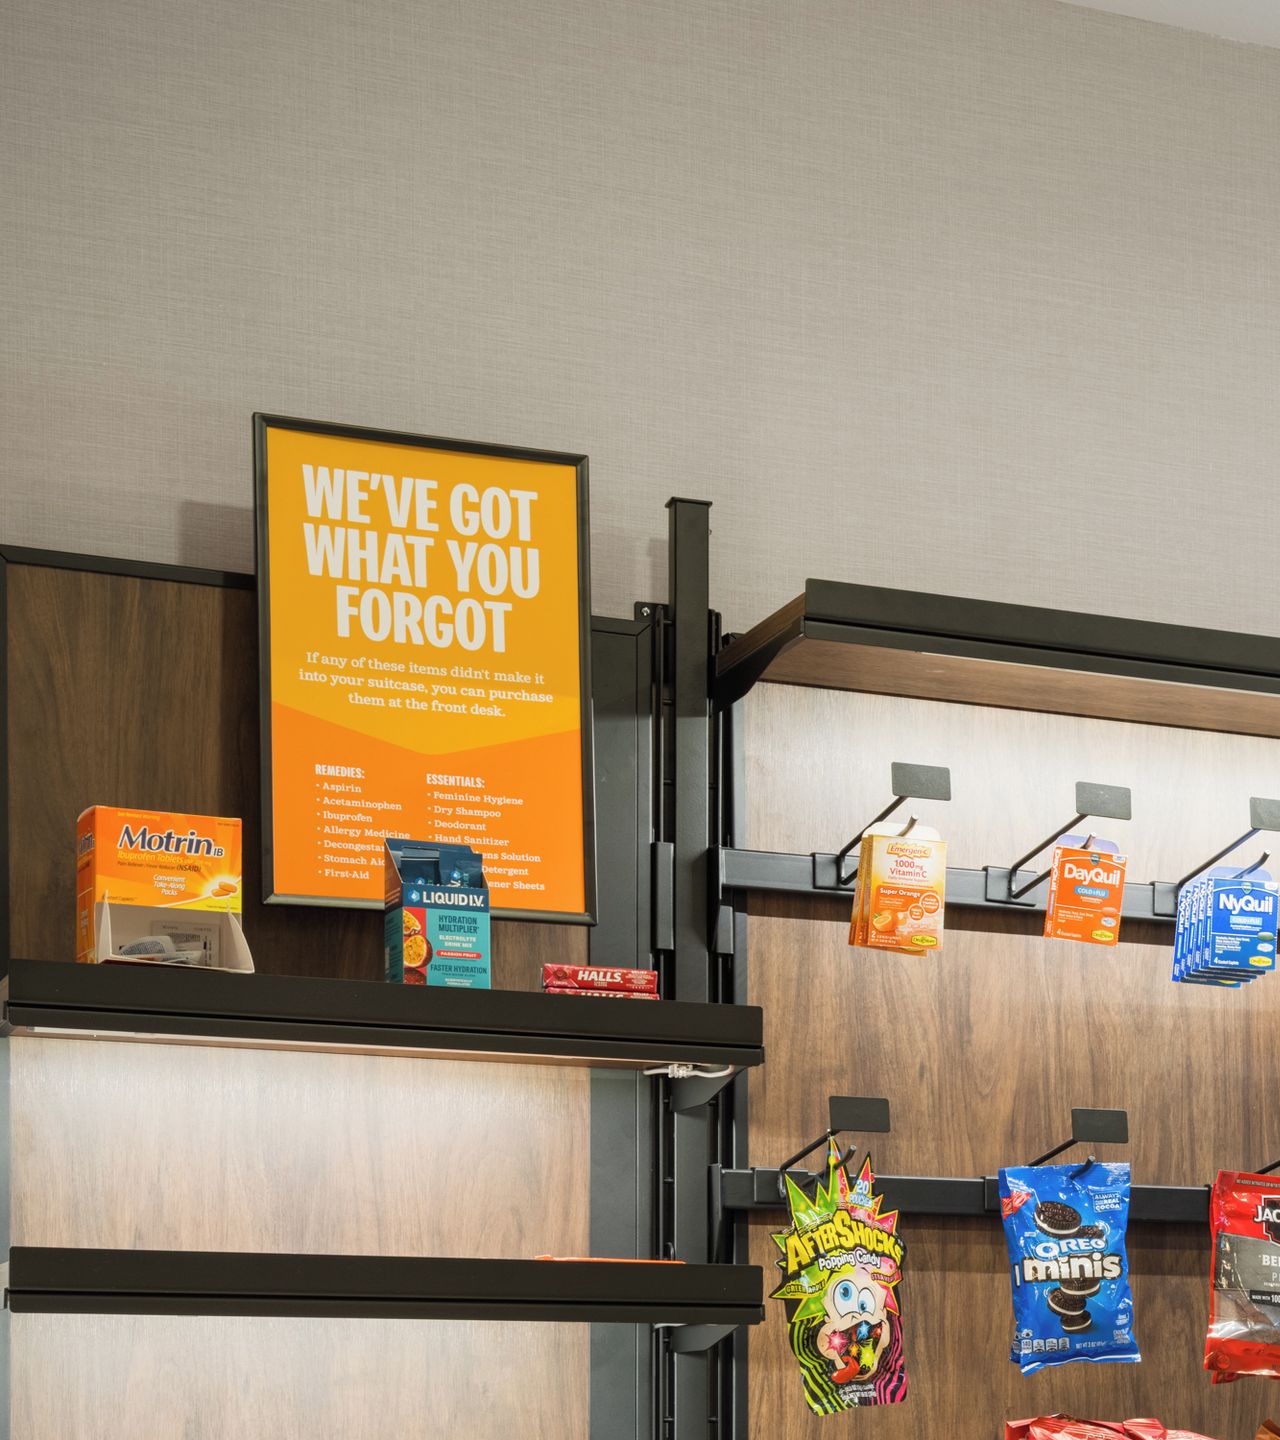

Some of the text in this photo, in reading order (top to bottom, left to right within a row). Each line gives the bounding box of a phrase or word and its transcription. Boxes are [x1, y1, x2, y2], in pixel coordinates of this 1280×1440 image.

[302, 464, 538, 542] WE'VE GOT
[303, 523, 540, 598] WHAT YOU
[336, 586, 512, 653] FORGOT
[306, 652, 544, 684] If any of these items didn't make it
[299, 669, 553, 703] into your suitcase, you can purchase
[348, 693, 506, 717] them at the front desk.
[315, 764, 365, 779] REMEDIES:
[322, 782, 362, 793] Aspirin
[426, 773, 485, 789] ESSENTIALS:
[323, 796, 402, 811] Acetaminophen
[433, 791, 523, 806] Feminine Hygiene
[323, 811, 373, 823] Ibuprofen
[434, 806, 501, 819] Dry Shampoo
[323, 825, 411, 839] Allergy Medicine
[434, 819, 487, 830] Deodorant
[118, 824, 213, 857] Motrin
[435, 833, 510, 847] Hand Sanitizer
[324, 854, 367, 866] Stomach
[500, 851, 541, 863] Solution
[324, 868, 370, 880] First-Aid
[1064, 863, 1121, 886] DayQuil
[513, 880, 545, 891] Sheets
[422, 891, 468, 906] LIQUID
[1219, 894, 1274, 915] NyQuil
[438, 915, 477, 925] HYDRATION
[577, 970, 622, 984] HALLS
[1035, 1237, 1107, 1260] OREO
[818, 1249, 882, 1271] Popping Candy
[1023, 1253, 1123, 1283] minis
